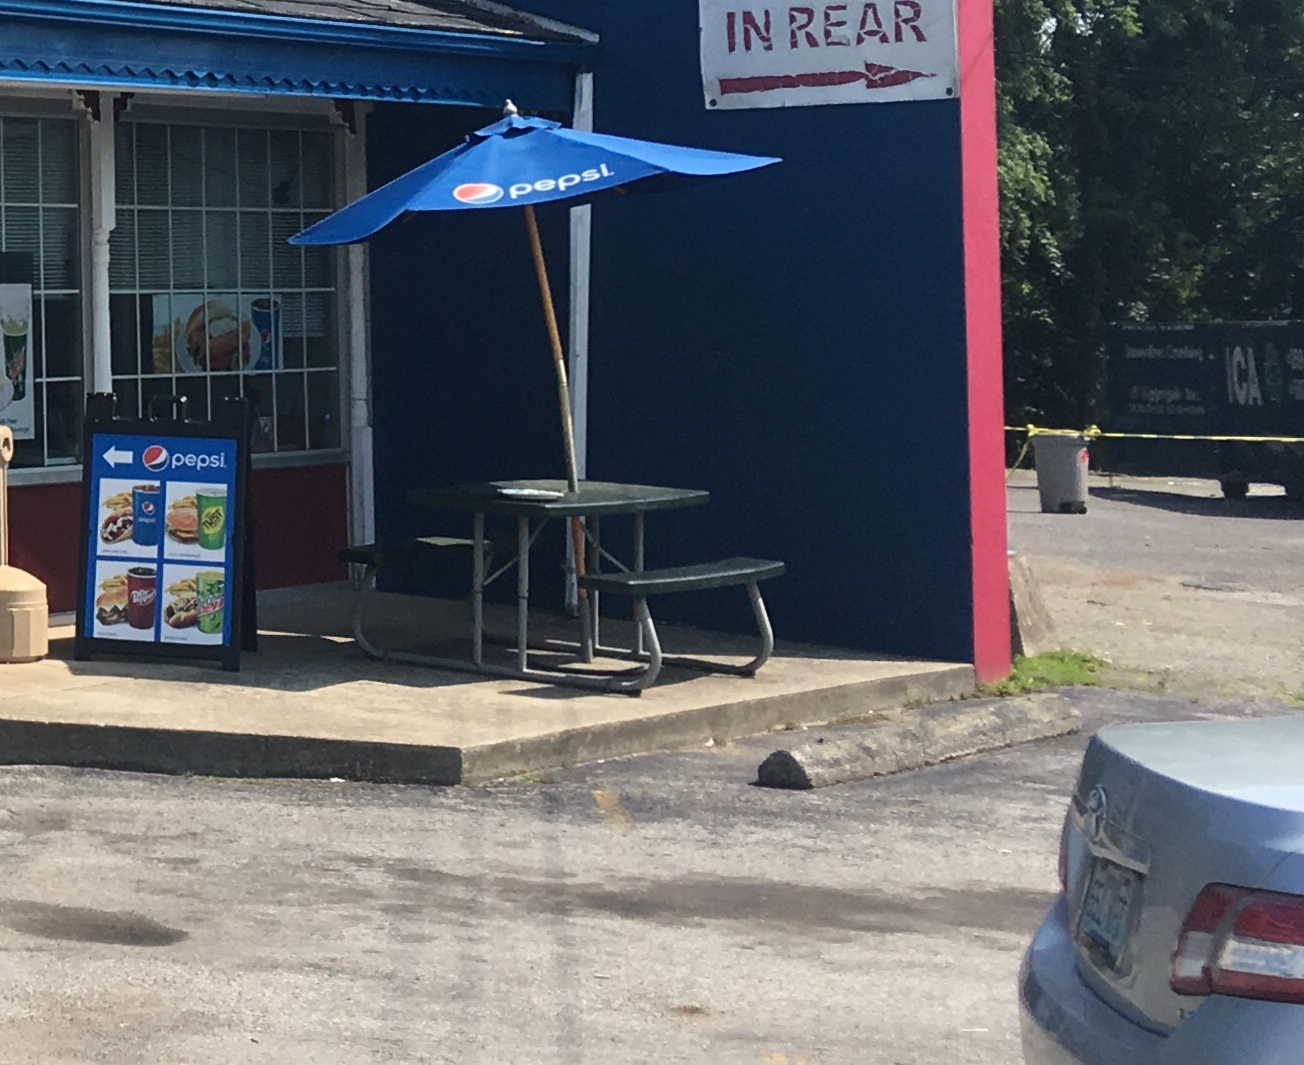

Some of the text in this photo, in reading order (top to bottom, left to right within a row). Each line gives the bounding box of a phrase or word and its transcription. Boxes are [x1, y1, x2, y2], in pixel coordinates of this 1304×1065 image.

[726, 0, 928, 53] IN REAR
[508, 162, 610, 200] pepsi
[171, 451, 225, 471] pepsi
